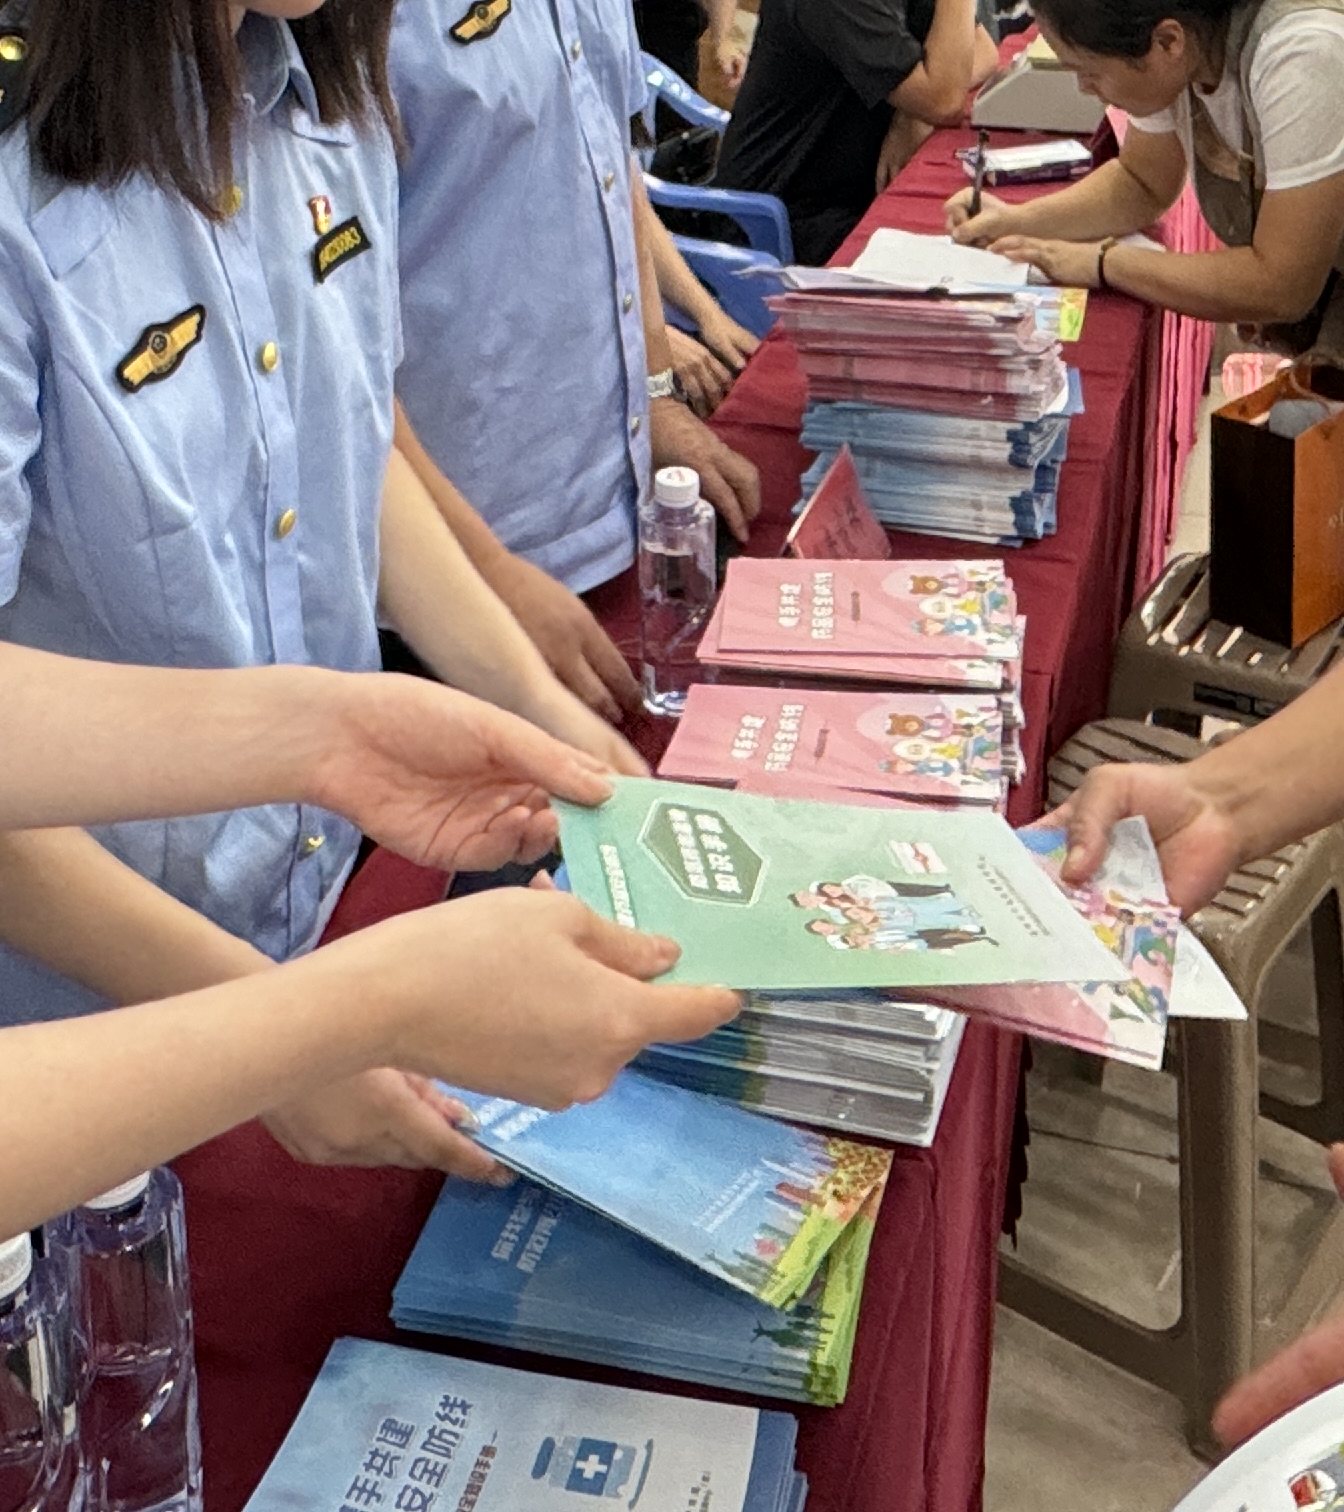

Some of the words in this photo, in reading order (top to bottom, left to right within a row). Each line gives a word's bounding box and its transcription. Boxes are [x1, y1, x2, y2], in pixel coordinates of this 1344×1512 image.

[339, 1417, 416, 1512] 手共建
[395, 1393, 474, 1512] 安全防线
